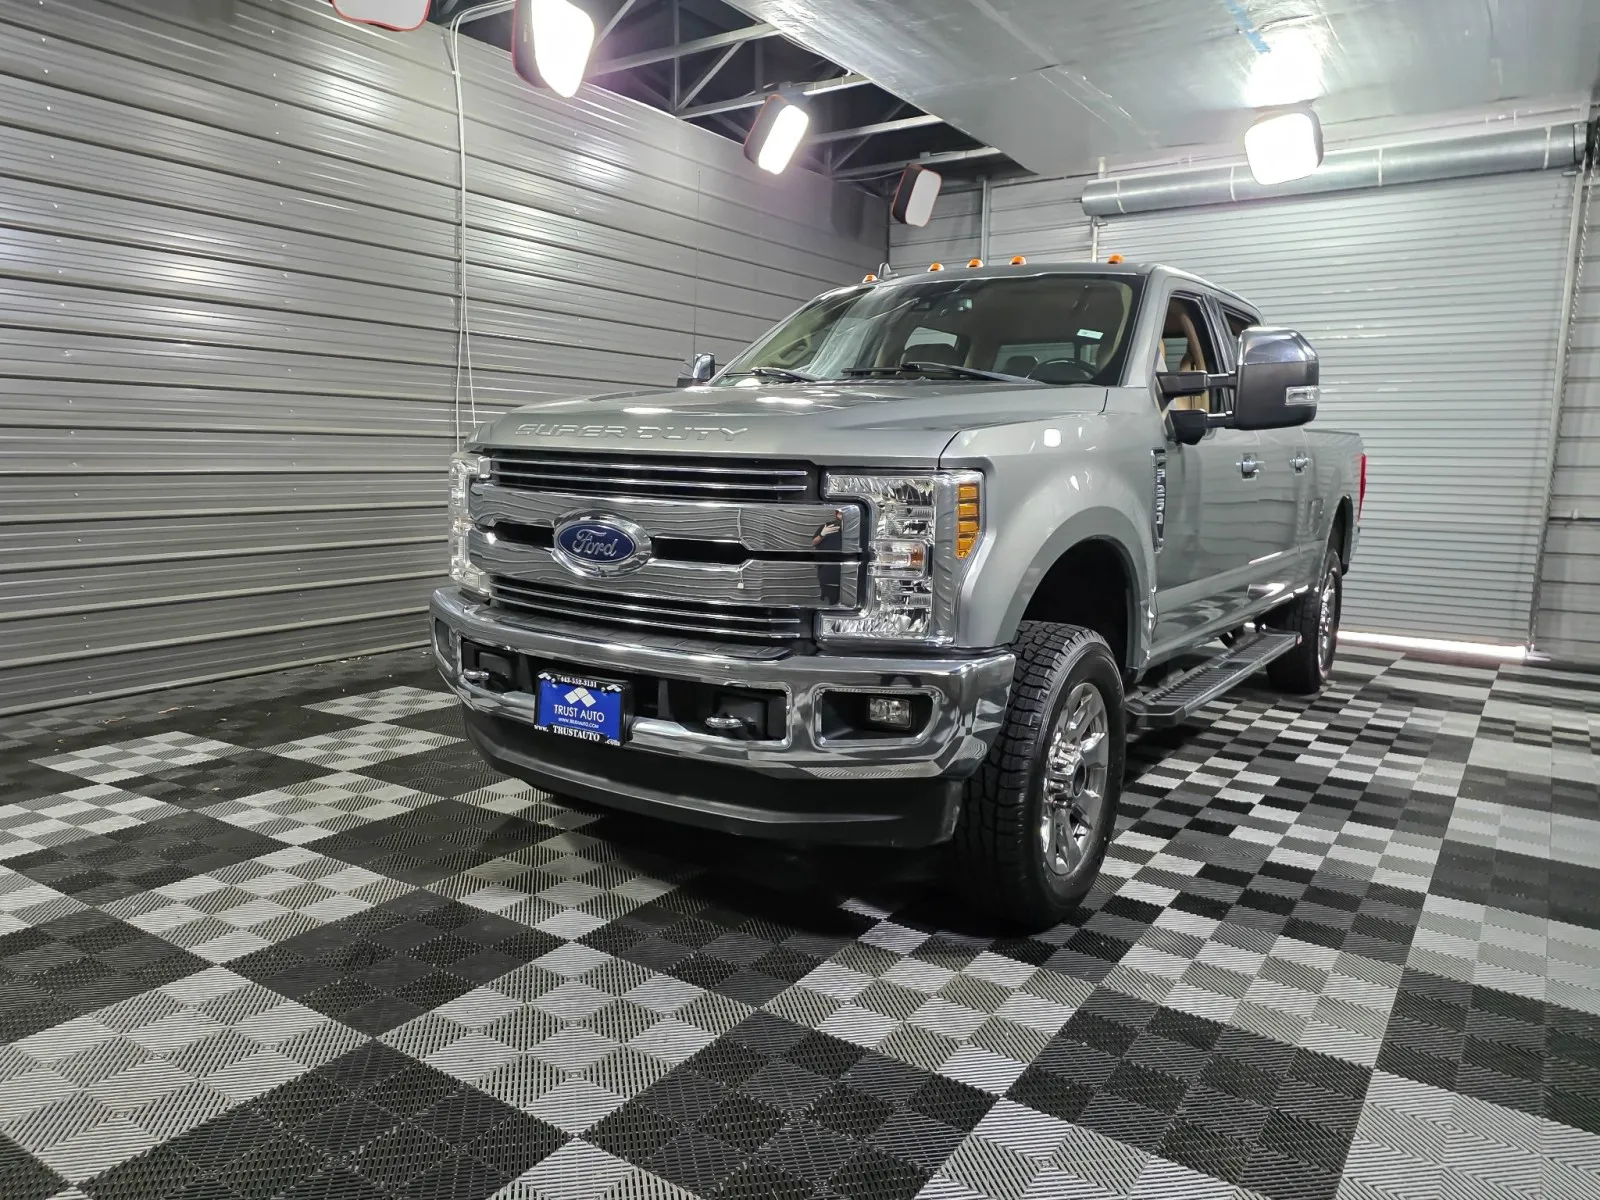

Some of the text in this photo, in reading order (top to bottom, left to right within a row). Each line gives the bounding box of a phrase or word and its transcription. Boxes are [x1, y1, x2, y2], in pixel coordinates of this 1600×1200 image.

[515, 423, 748, 442] SUPER DUTY
[572, 528, 618, 557] Ford
[554, 704, 605, 723] TRUST AUTO
[553, 724, 600, 742] TRUSTAUTO
